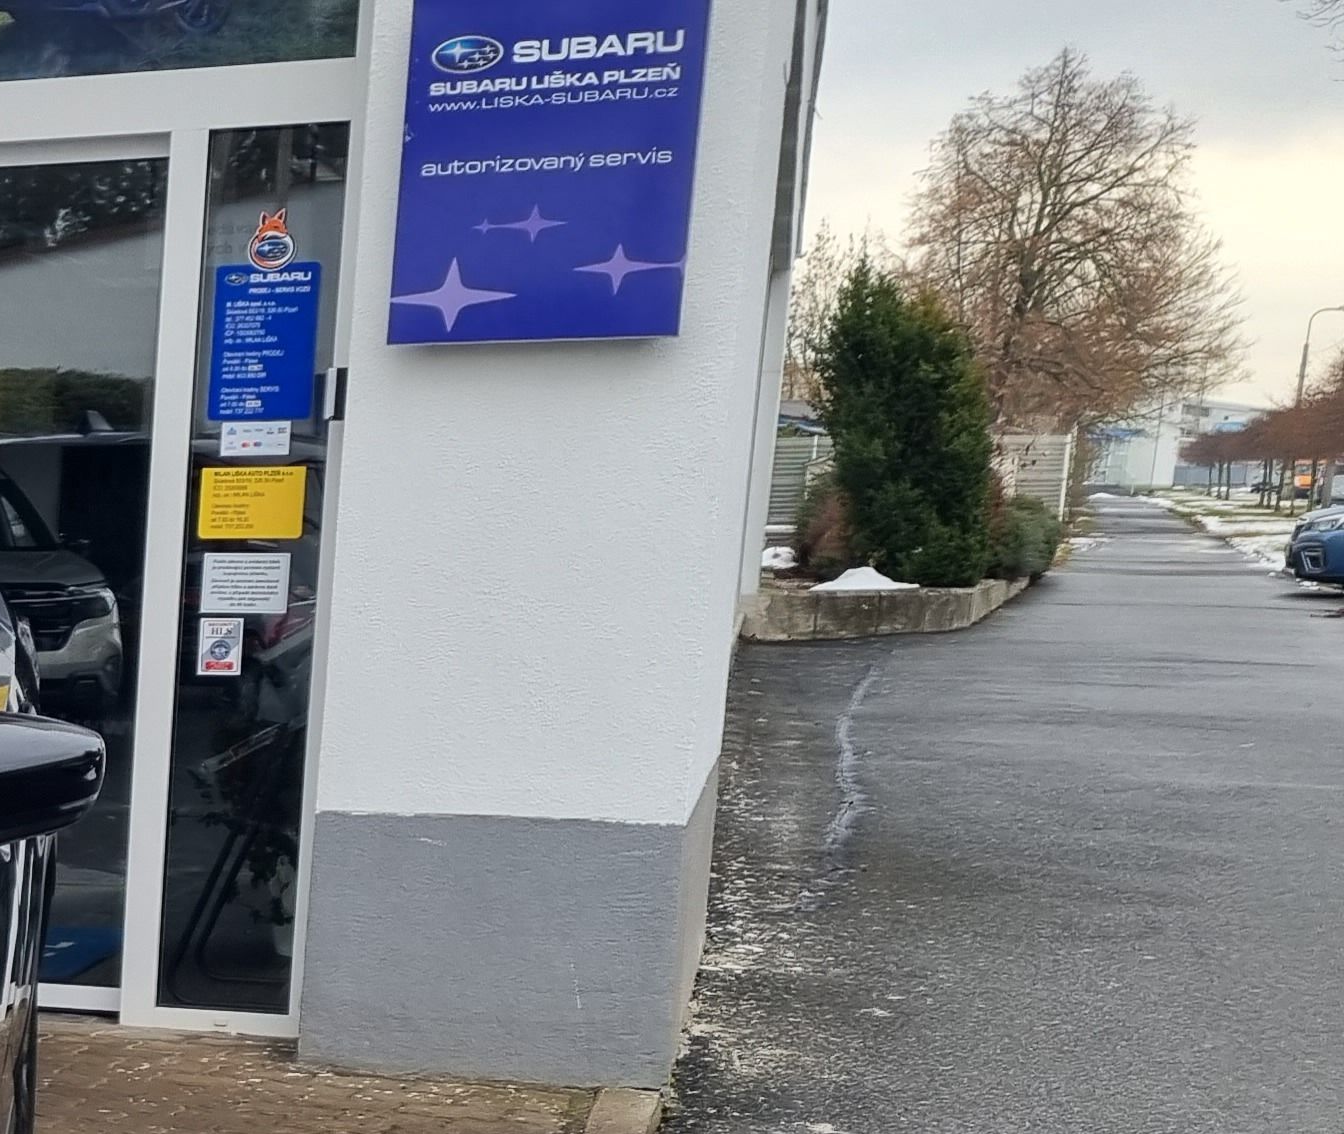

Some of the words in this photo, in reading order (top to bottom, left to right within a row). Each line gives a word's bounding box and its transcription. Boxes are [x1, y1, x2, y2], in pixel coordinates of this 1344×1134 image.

[512, 29, 685, 63] SUBARU
[429, 76, 528, 96] SUBARU
[530, 71, 600, 89] LIŠKA
[602, 62, 681, 84] PLZEŇ
[428, 87, 679, 112] www.LISKA-SUBARU.cz
[421, 153, 586, 177] autorizovaný
[588, 146, 673, 167] servis
[249, 271, 312, 283] SUBARU
